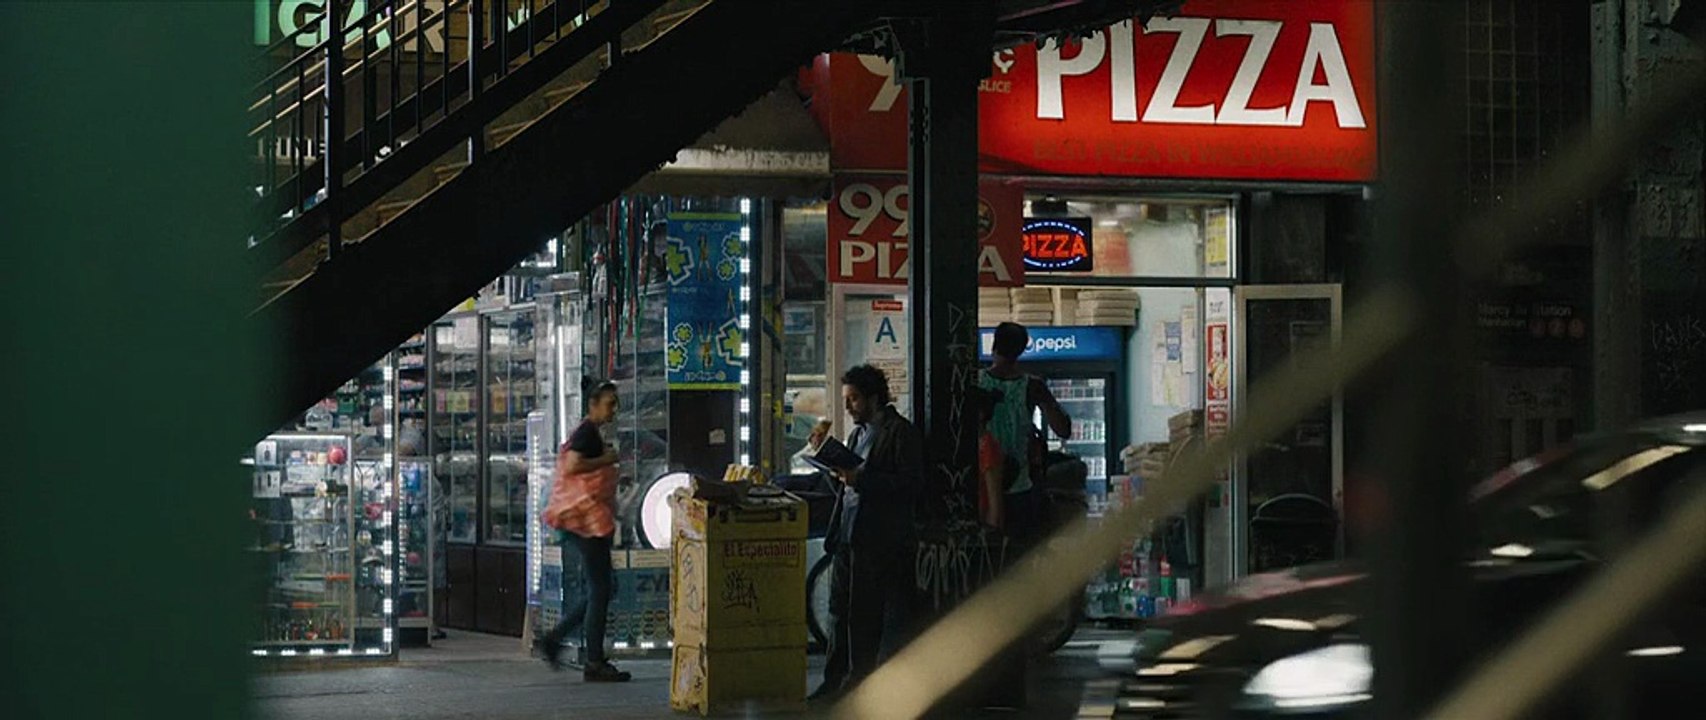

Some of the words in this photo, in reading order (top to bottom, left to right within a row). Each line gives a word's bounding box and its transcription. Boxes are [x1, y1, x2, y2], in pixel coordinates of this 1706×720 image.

[1037, 16, 1366, 128] PIZZA
[875, 316, 897, 342] A
[1035, 335, 1076, 353] pepsi
[724, 543, 735, 557] El
